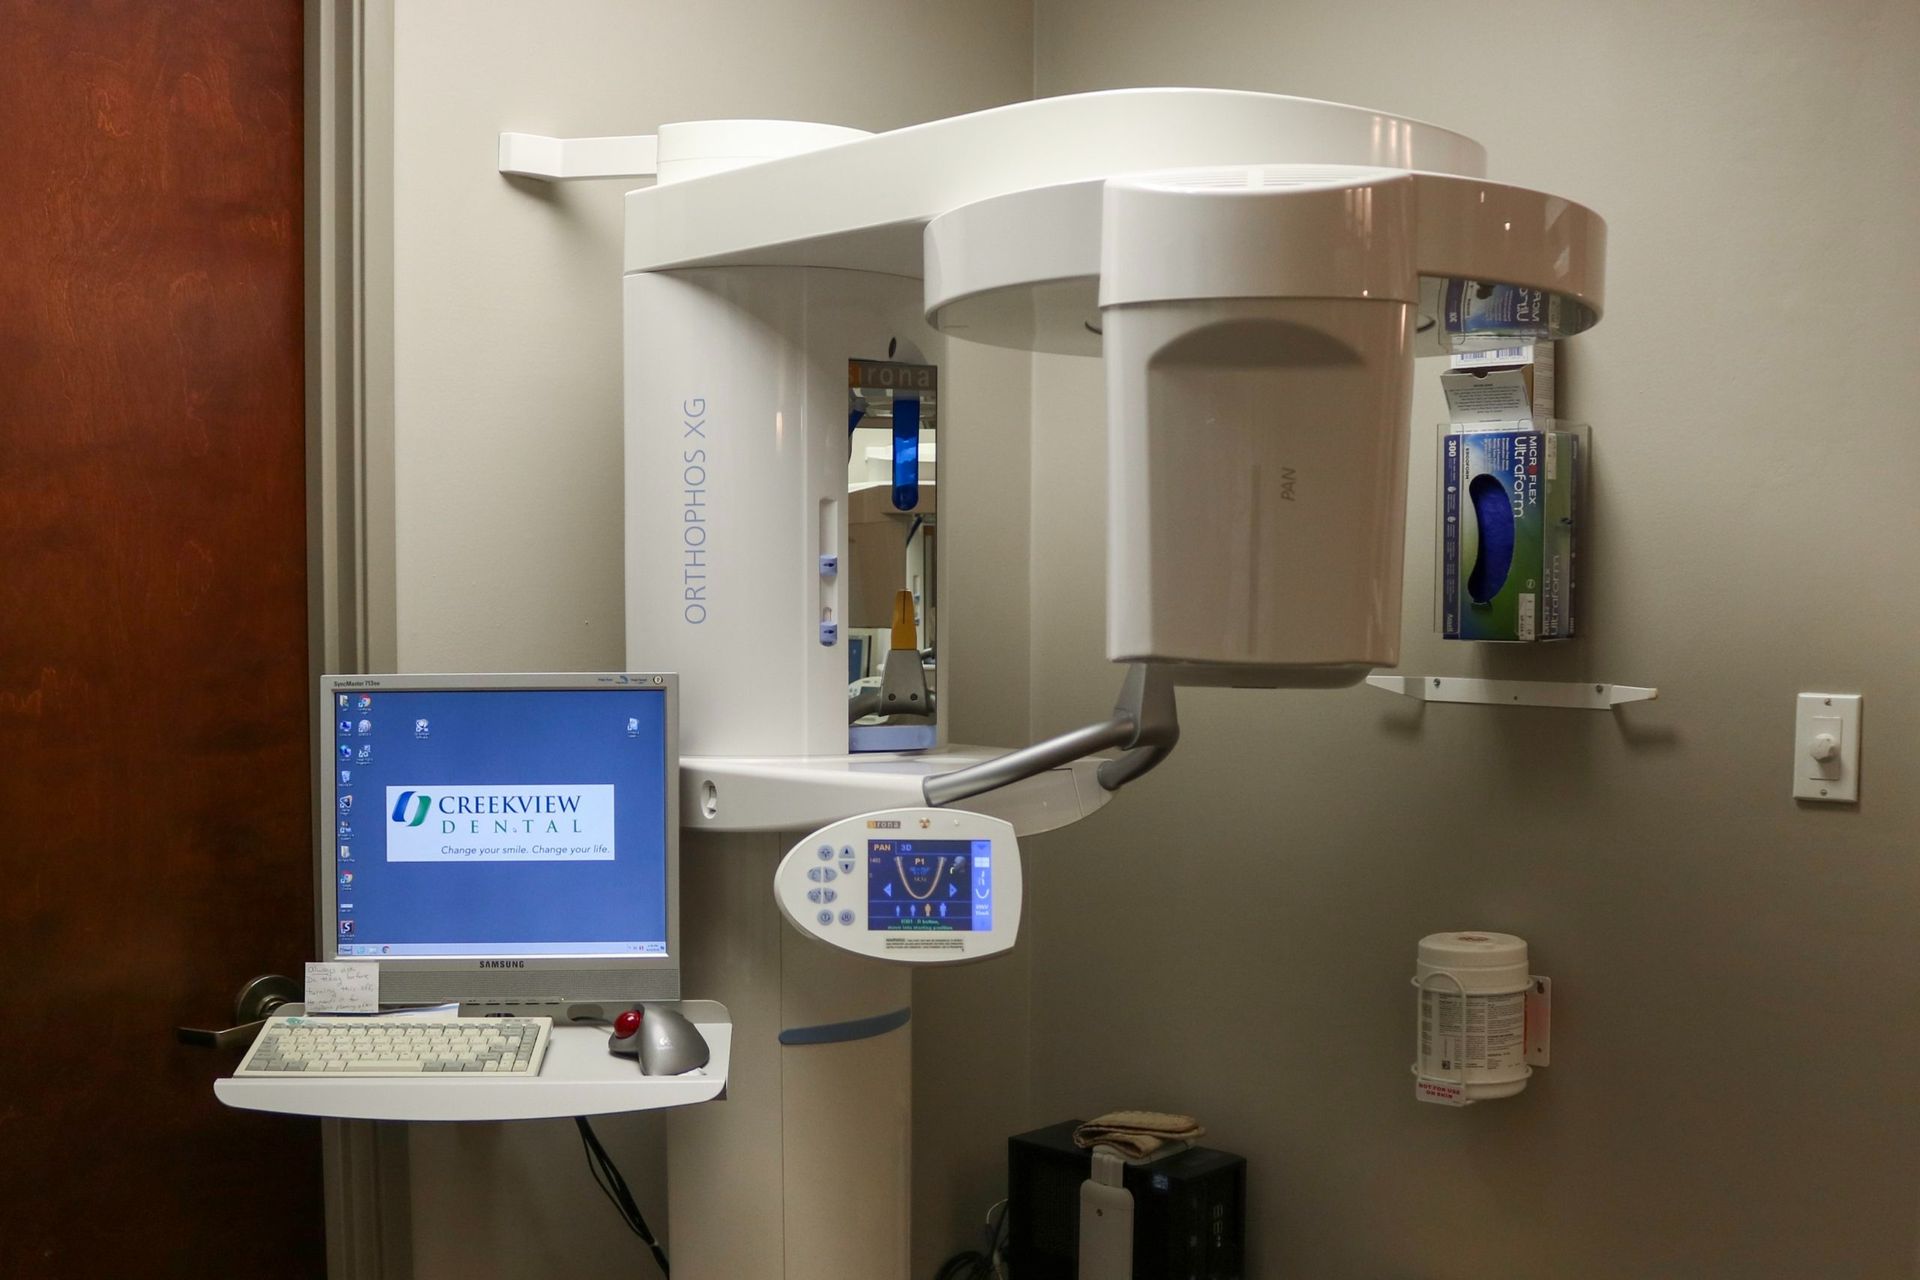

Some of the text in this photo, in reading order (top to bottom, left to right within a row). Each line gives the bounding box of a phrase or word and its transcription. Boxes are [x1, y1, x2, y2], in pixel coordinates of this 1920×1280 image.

[1448, 440, 1456, 457] 300
[1280, 466, 1296, 502] PAN
[1514, 436, 1527, 518] Ultraform
[684, 398, 706, 625] ORTHOPHOS XG
[438, 795, 582, 814] CREEKVIEW
[442, 819, 582, 834] DENTAL
[441, 844, 610, 856] Change your smile. Change your life.
[873, 843, 891, 851] PAN
[901, 843, 912, 851] 3D
[479, 960, 525, 969] SAMSUNG
[1418, 1082, 1432, 1090] NOT
